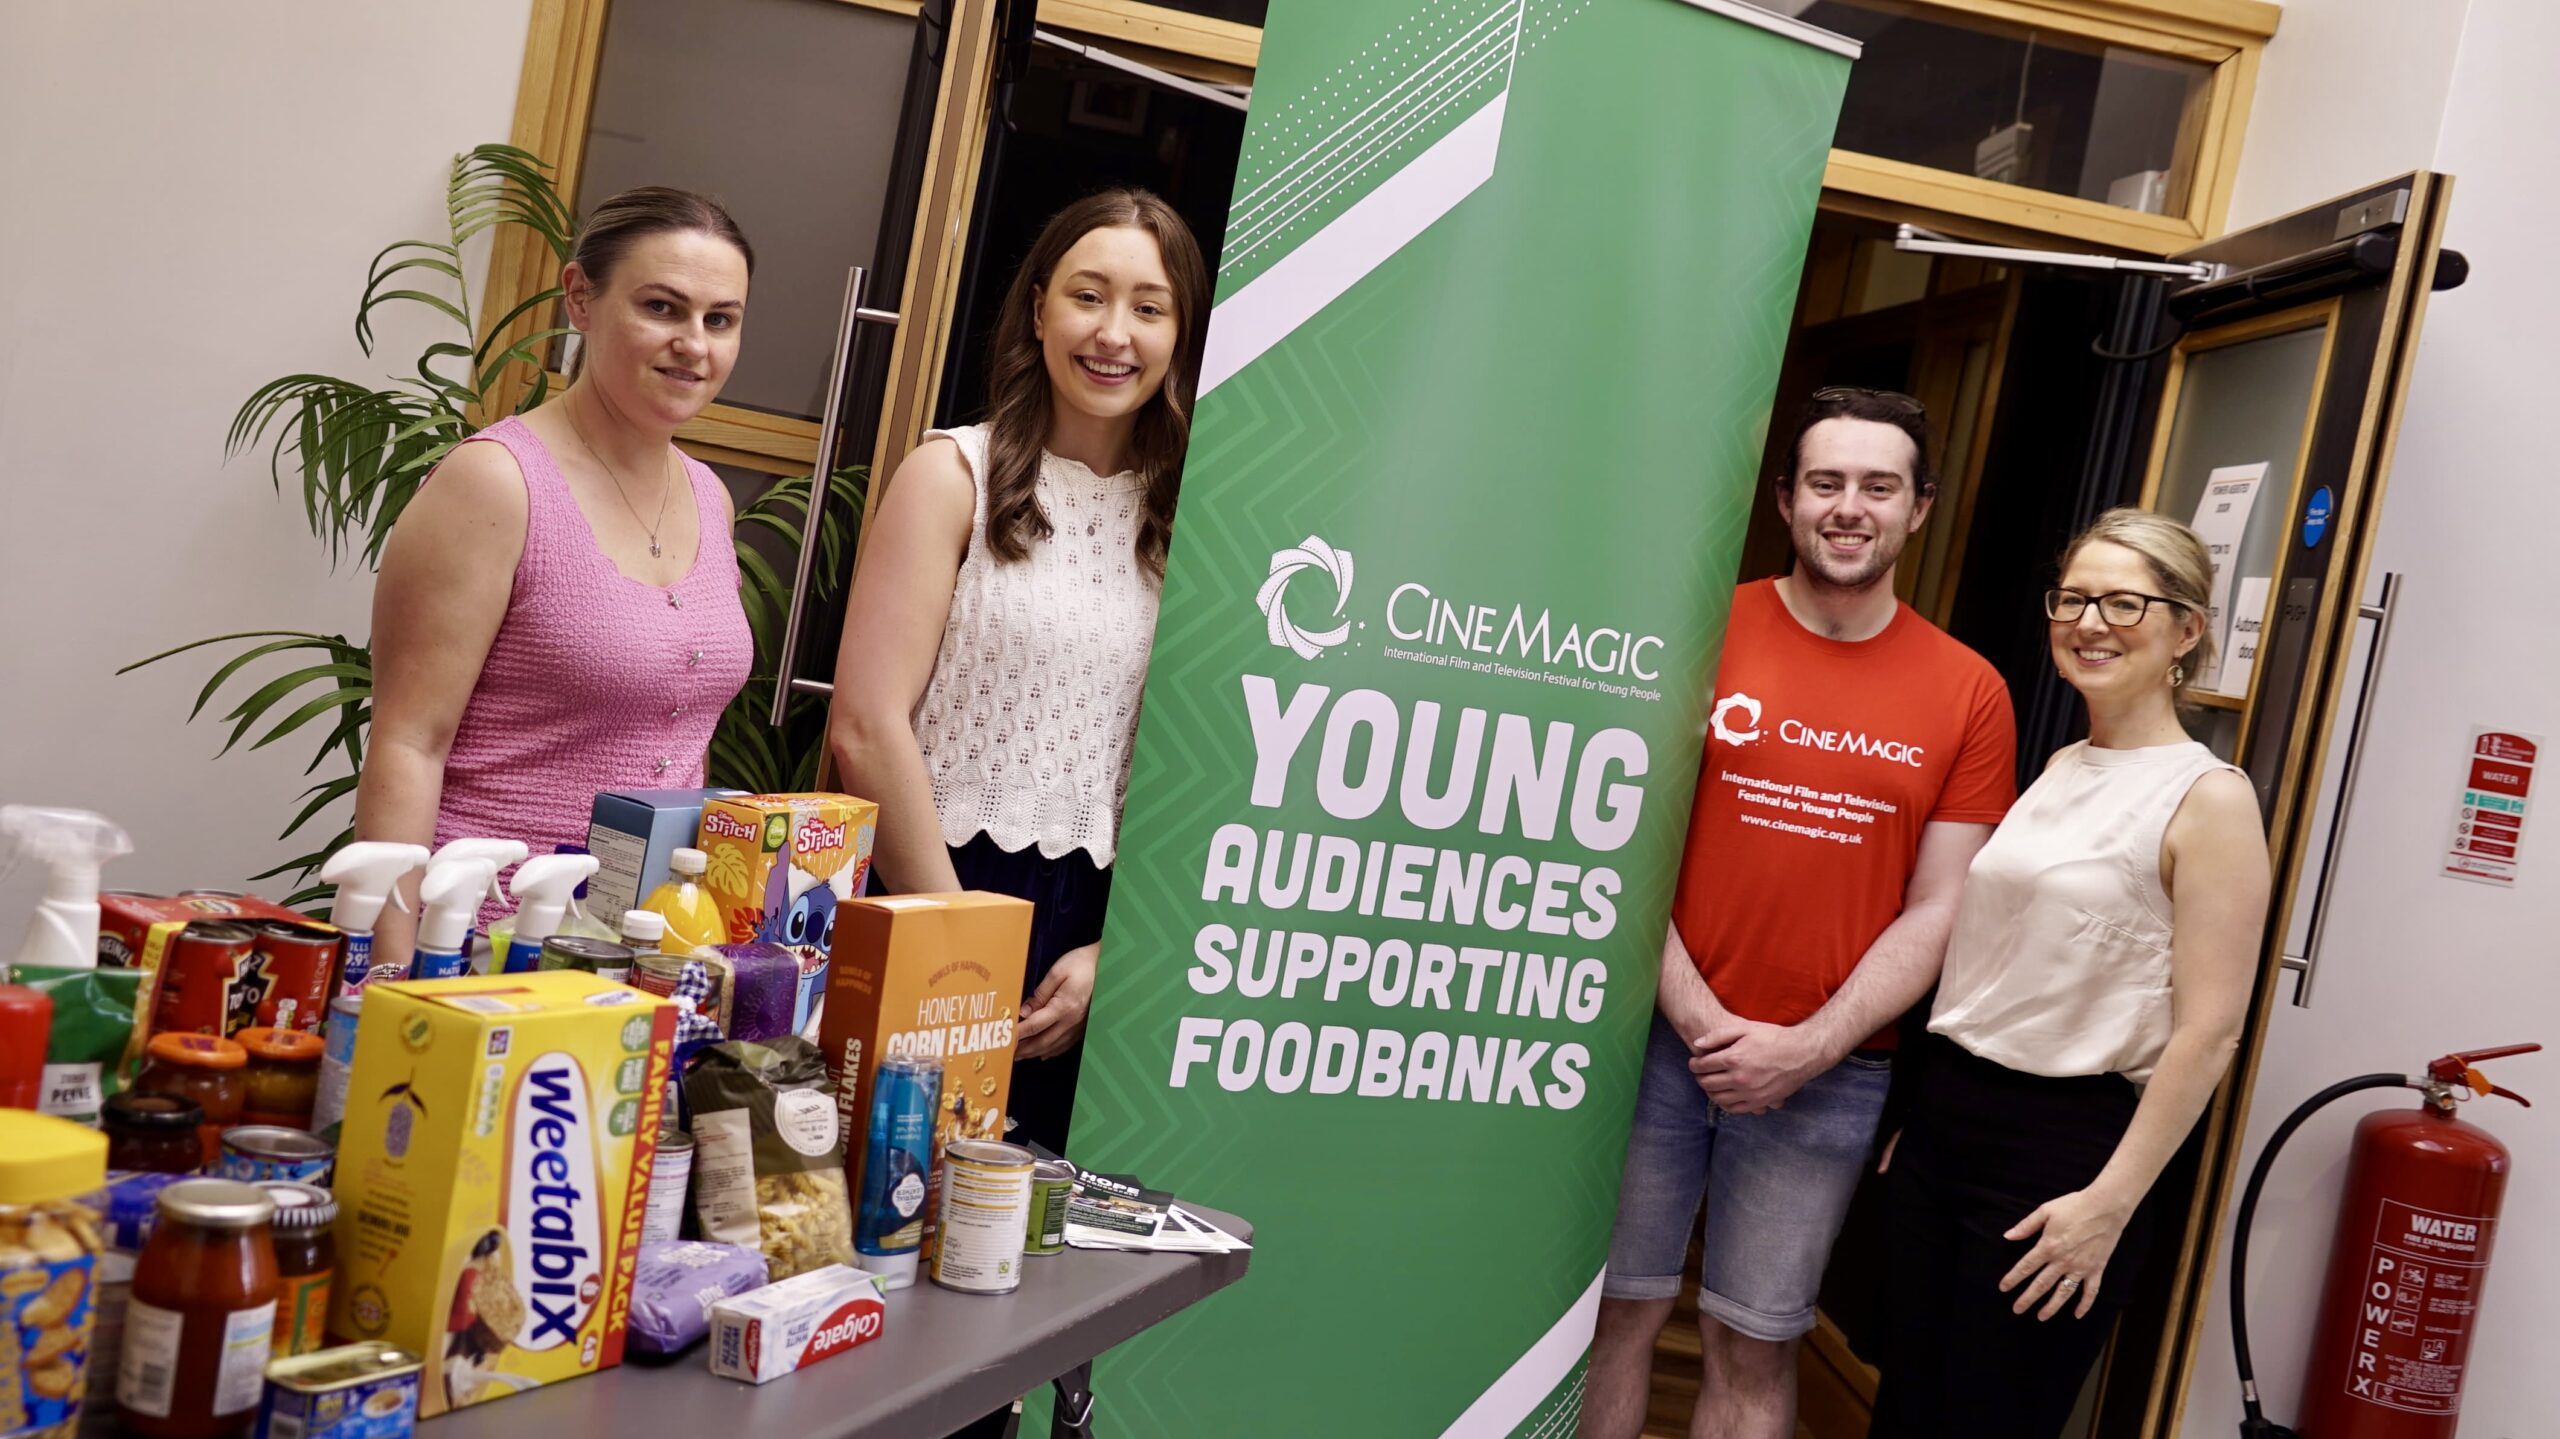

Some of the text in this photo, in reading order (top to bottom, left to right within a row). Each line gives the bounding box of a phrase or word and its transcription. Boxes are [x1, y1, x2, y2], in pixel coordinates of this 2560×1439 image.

[1384, 645, 1662, 702] International Film and Television Festival for Young People
[1241, 673, 1649, 851] YOUNG
[2482, 771, 2519, 785] WATER
[1721, 770, 1897, 814] International Film and Television
[1737, 788, 1875, 824] Festival for Young People
[1740, 812, 1864, 845] www.cinemagic.org.uk
[1201, 823, 1622, 940] AUDIENCES
[1187, 923, 1608, 1024] SUPPORTING
[917, 991, 998, 1026] HONEY NUT
[887, 1017, 1014, 1057] CORN FLAKES
[839, 1037, 862, 1111] FLAKES
[1169, 1016, 1592, 1110] FOODBANKS
[640, 1038, 670, 1145] FAMILY
[530, 1067, 588, 1345] Weetabix
[622, 1150, 654, 1251] VALUE
[1080, 1171, 1140, 1195] HOPE
[2404, 1233, 2422, 1243] FIRE
[2411, 1214, 2477, 1242] WATER
[609, 1254, 635, 1333] PACK
[814, 1311, 880, 1351] Colgate
